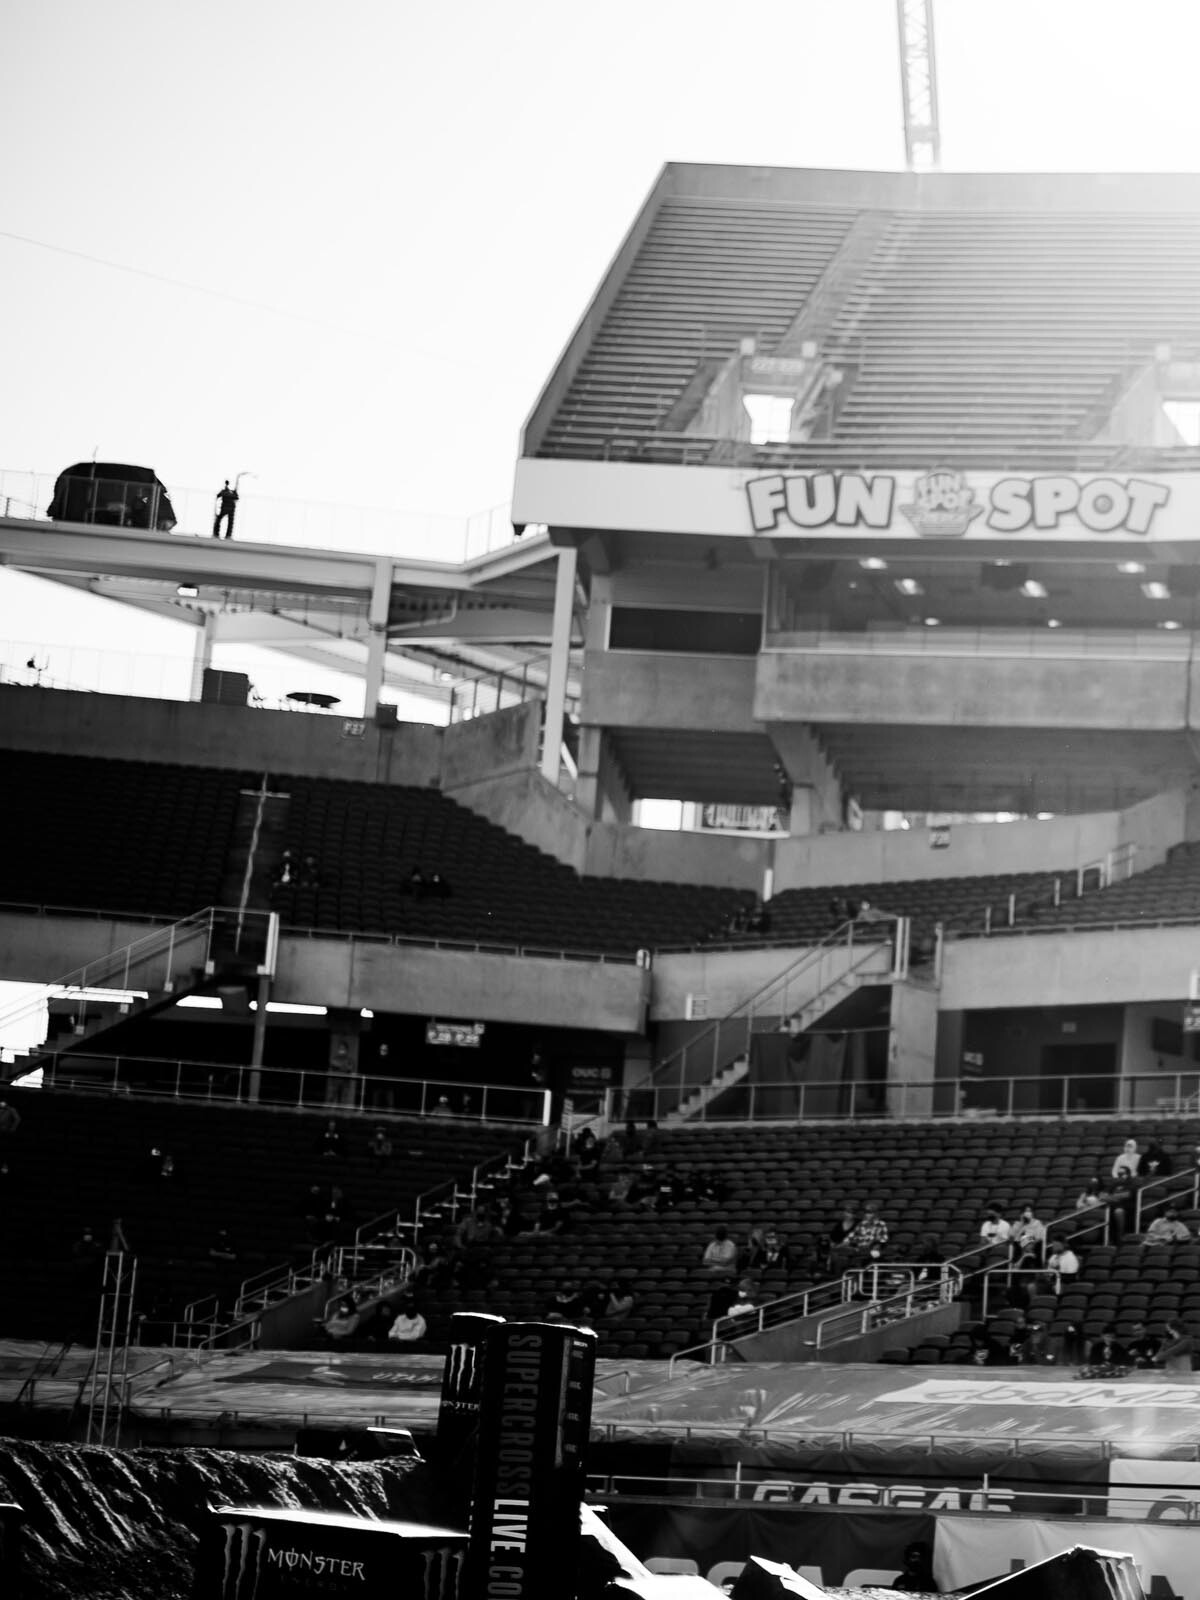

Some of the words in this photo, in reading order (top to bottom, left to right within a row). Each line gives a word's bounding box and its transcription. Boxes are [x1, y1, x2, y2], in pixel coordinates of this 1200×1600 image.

[746, 469, 895, 534] FUN
[986, 475, 1171, 534] SPOT
[486, 1333, 544, 1600] SUPERCROSSLIVE.CO
[266, 1547, 367, 1582] MONSTER
